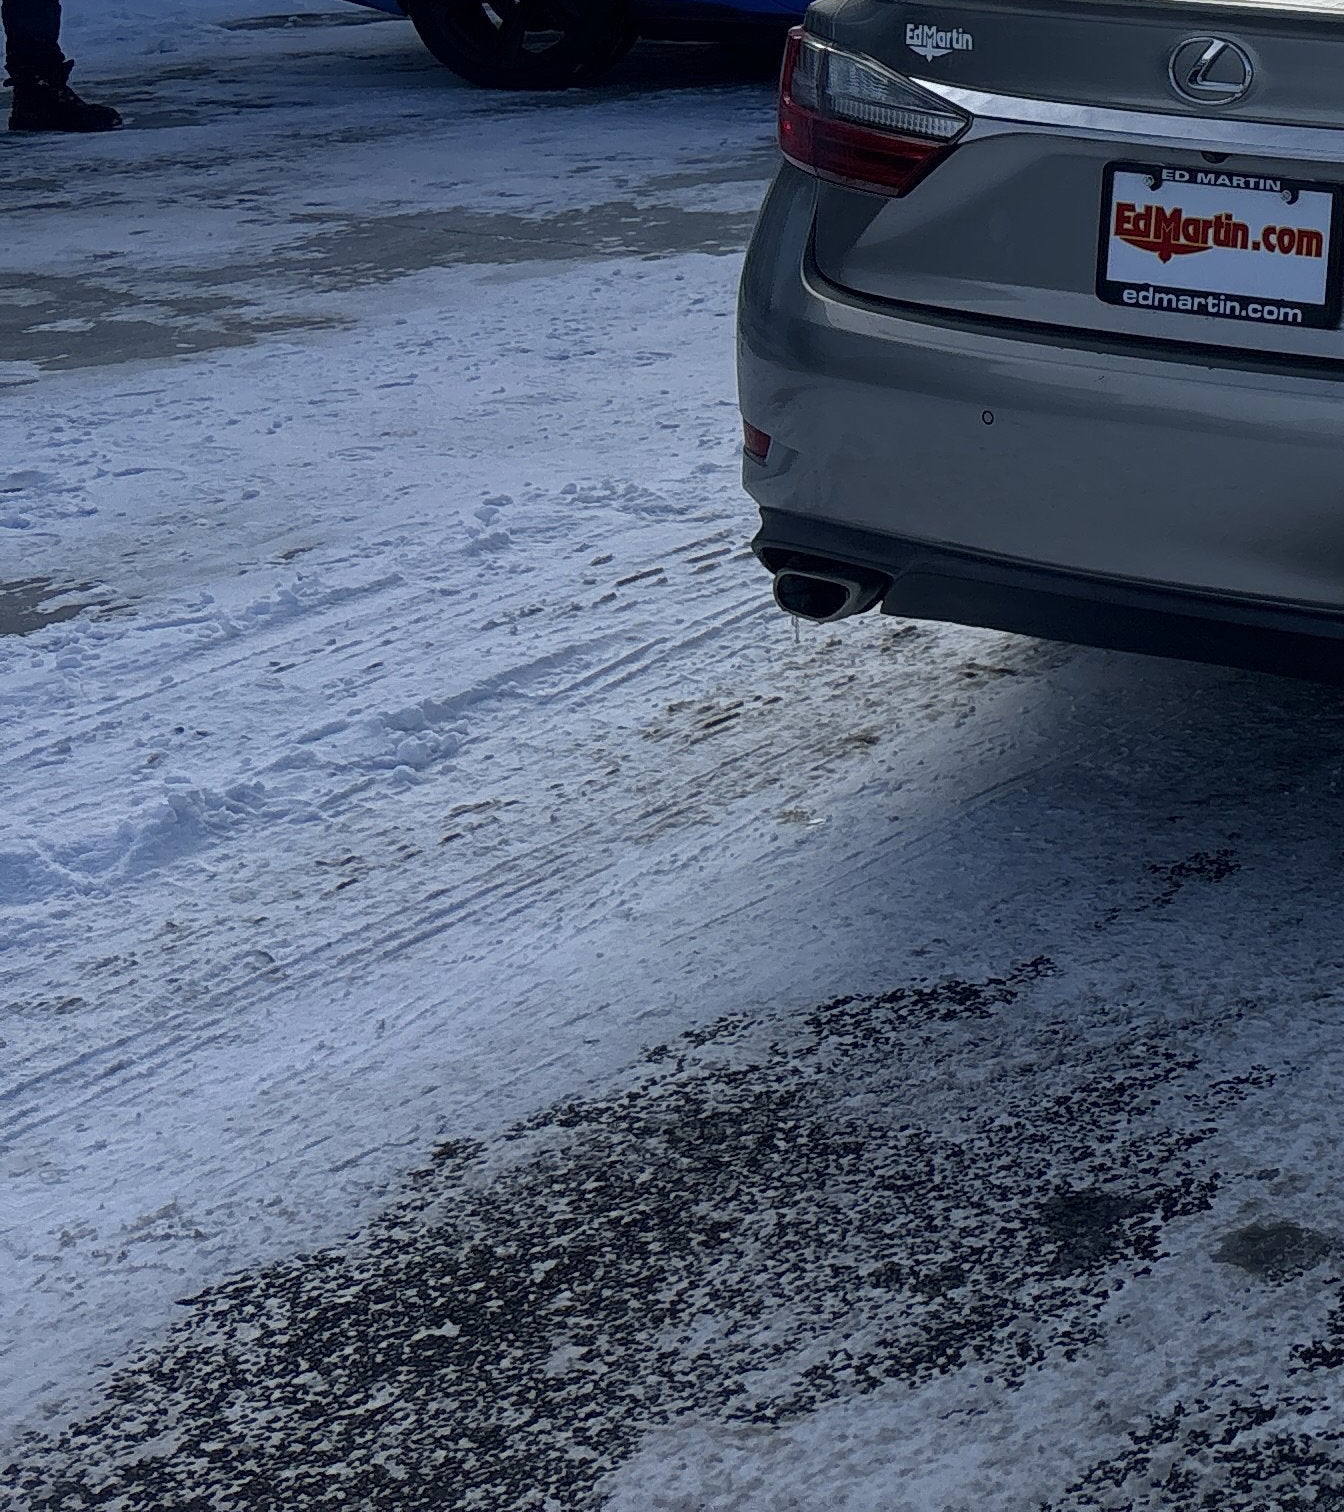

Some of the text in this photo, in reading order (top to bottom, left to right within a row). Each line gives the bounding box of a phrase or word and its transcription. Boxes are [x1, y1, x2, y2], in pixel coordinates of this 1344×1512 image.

[906, 23, 973, 52] EdMartin
[1161, 169, 1281, 191] ED MARTIN
[1114, 201, 1324, 260] EdMartin.com
[1122, 287, 1303, 323] edmartin.com
